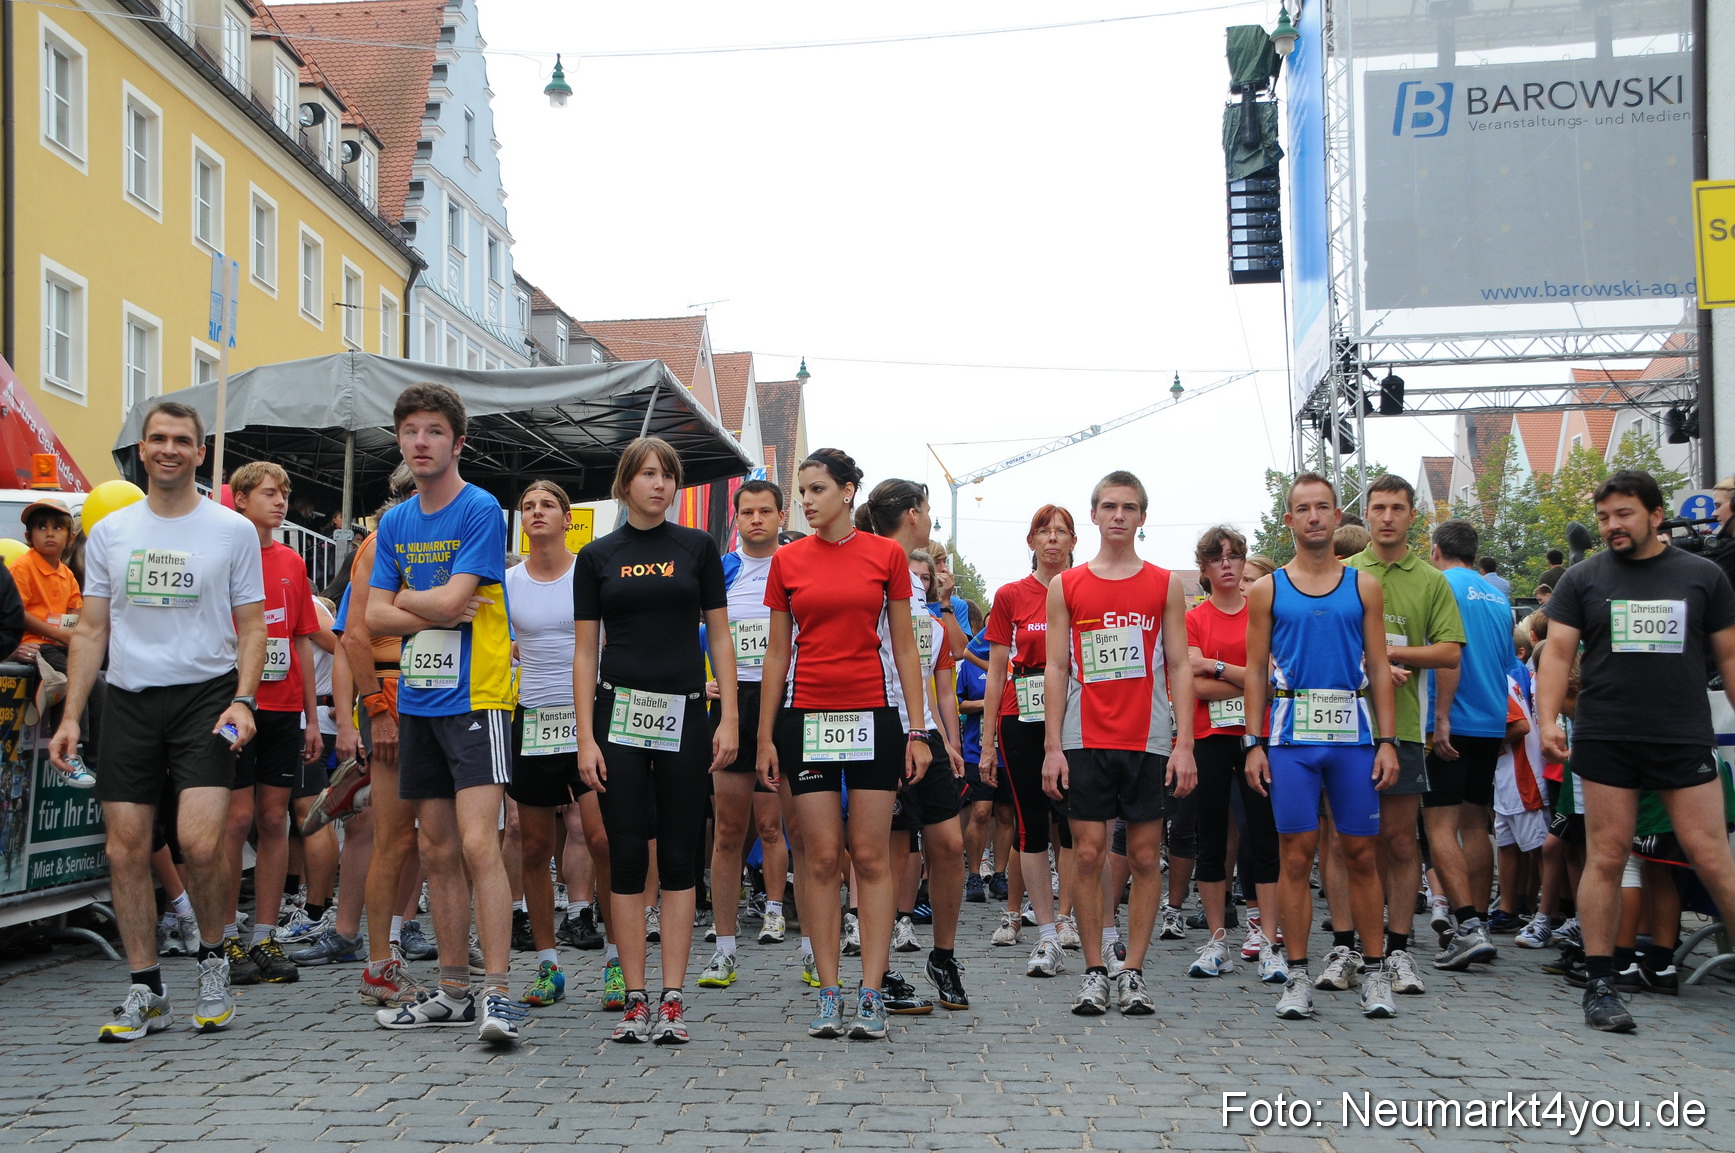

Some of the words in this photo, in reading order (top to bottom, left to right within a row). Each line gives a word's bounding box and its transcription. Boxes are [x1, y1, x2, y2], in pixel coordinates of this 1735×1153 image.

[1466, 75, 1683, 116] BAROWSKI
[1468, 114, 1588, 132] Veranstaltungs-
[1595, 112, 1625, 126] und
[1630, 109, 1692, 125] Medien
[148, 553, 186, 566] Matthes
[620, 562, 668, 578] ROXY
[147, 571, 195, 588] 5129
[1631, 604, 1674, 614] Christian
[739, 623, 763, 633] Martin
[1103, 612, 1155, 631] EnBW
[1614, 619, 1620, 627] S
[1633, 620, 1678, 635] 5002
[1095, 633, 1119, 645] Björn
[414, 653, 454, 669] 5254
[1084, 651, 1089, 659] S
[1099, 646, 1140, 664] 5172
[633, 694, 668, 709] Isabella
[1225, 700, 1244, 712] 50
[615, 708, 620, 717] S
[822, 712, 860, 722] Vanessa
[1313, 710, 1352, 723] 5157
[632, 712, 677, 732] 5042
[806, 728, 811, 736] S
[824, 728, 868, 743] 5015
[39, 799, 61, 831] für
[64, 797, 83, 828] Ihr
[34, 861, 55, 879] Miet
[56, 857, 64, 876] &
[65, 852, 95, 873] Service
